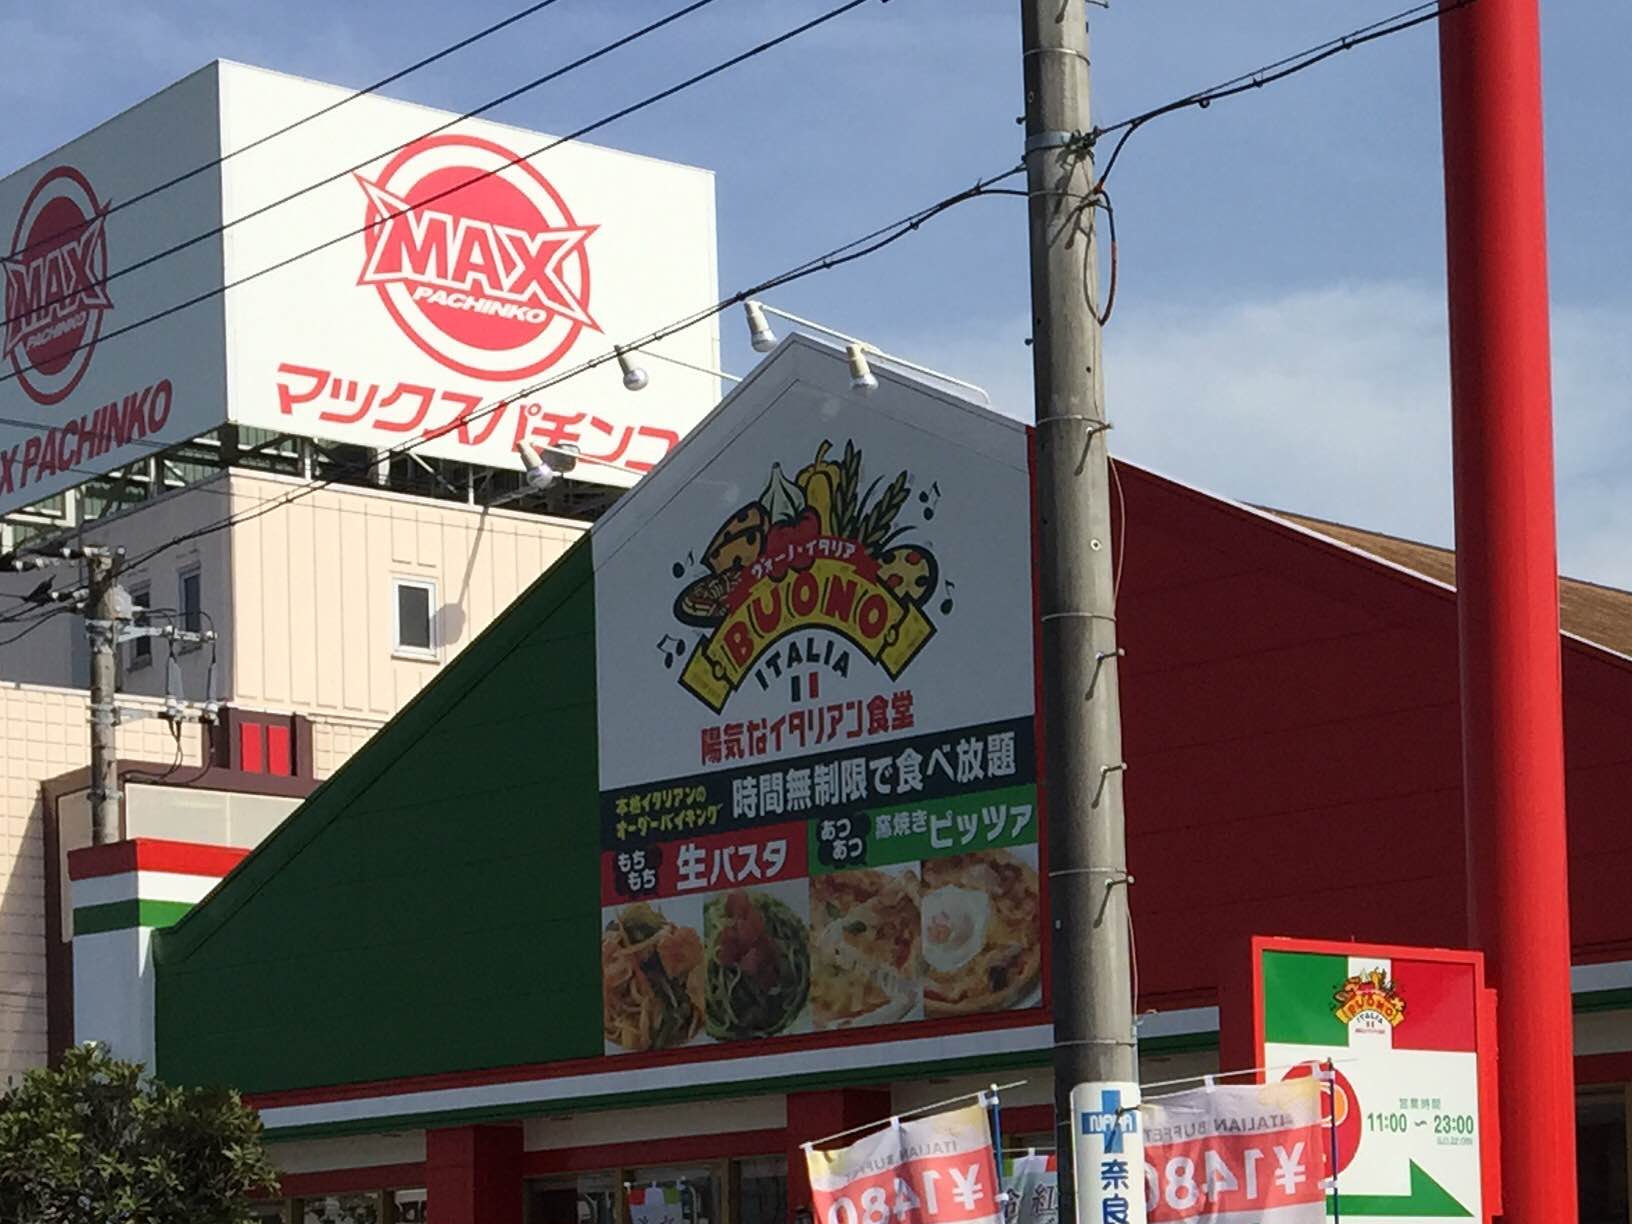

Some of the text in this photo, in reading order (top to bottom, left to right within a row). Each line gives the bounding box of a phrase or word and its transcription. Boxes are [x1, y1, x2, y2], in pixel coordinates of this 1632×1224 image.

[3, 205, 112, 358] MAX
[357, 176, 600, 330] MAX
[412, 285, 548, 324] PACHINKO
[20, 378, 173, 489] PACHINKO
[276, 362, 681, 473] マックスパチンコ
[723, 570, 889, 669] BUONO
[755, 637, 850, 691] ITALIA
[700, 690, 915, 766] 陽気なイタリアン食堂
[731, 731, 1016, 819] 時間無制限で食べ放題
[1367, 1112, 1408, 1133] 11:00
[1434, 1114, 1475, 1135] 23:00
